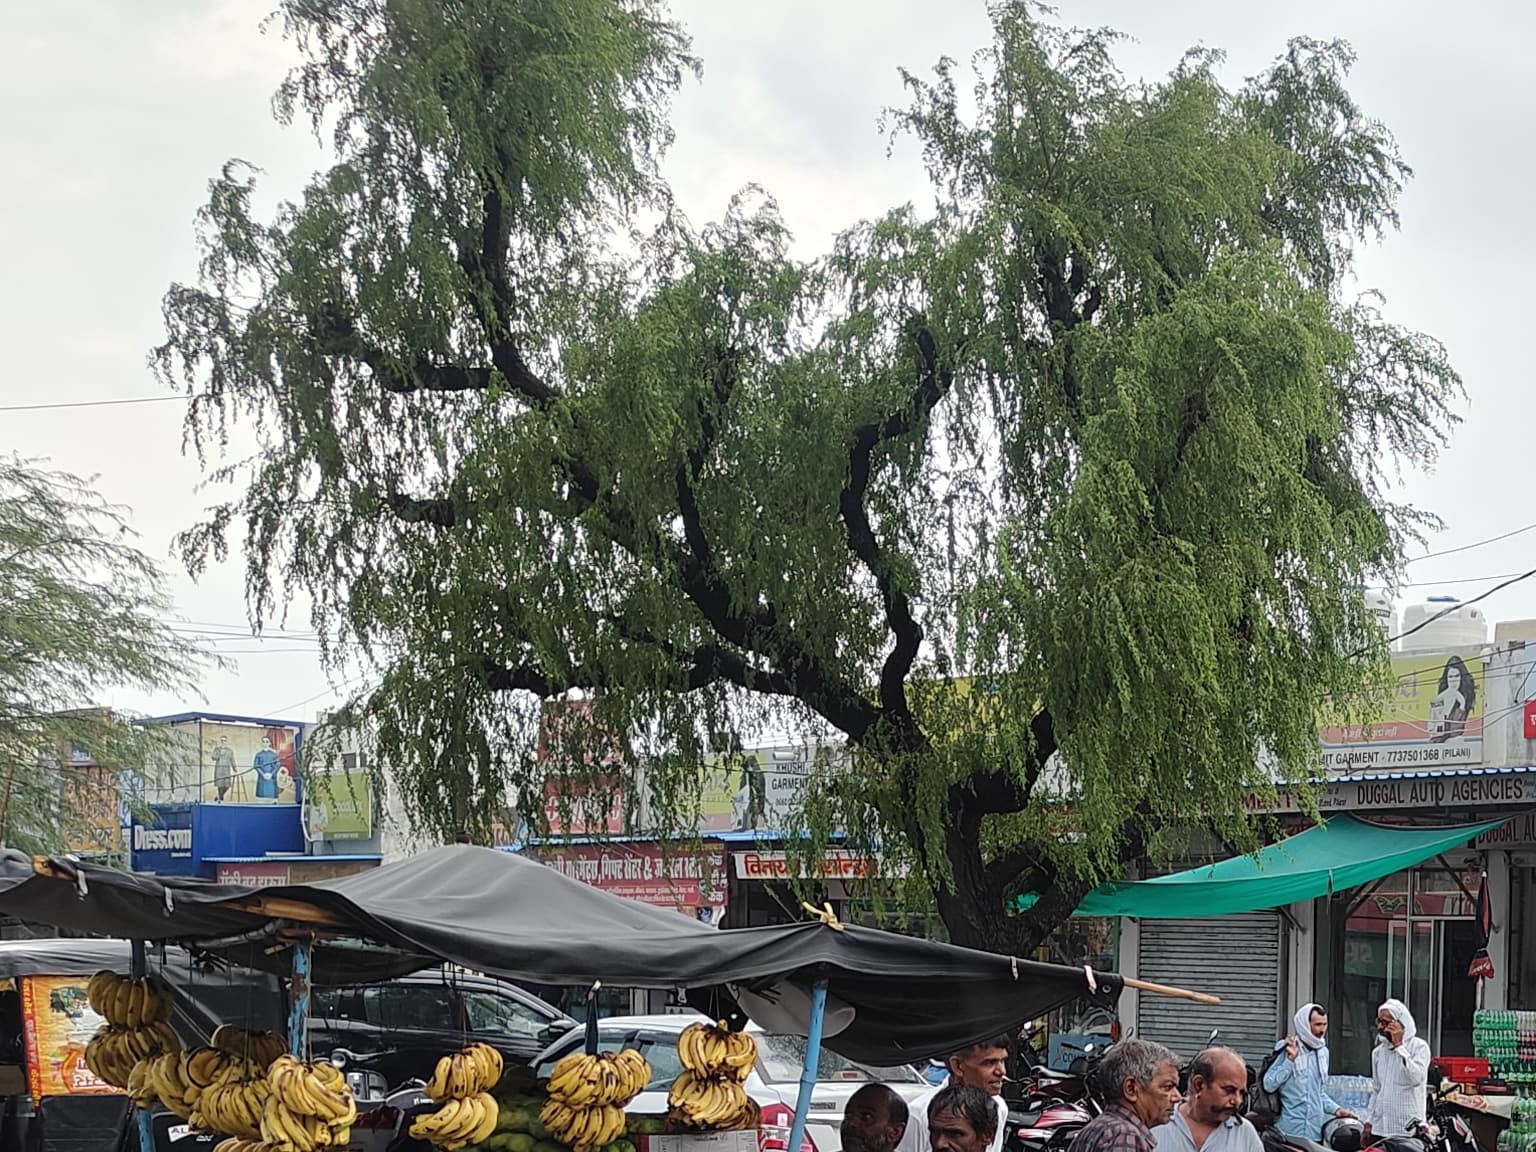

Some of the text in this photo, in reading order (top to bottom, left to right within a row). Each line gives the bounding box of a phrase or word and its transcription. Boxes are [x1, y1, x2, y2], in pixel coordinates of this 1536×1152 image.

[1336, 752, 1380, 764] GARMENT
[1387, 749, 1439, 763] 7737501368
[1357, 783, 1404, 806] DUGGAL
[1410, 781, 1445, 804] AUTO
[1452, 778, 1523, 801] AGENCIES
[134, 824, 192, 851] Dress.com
